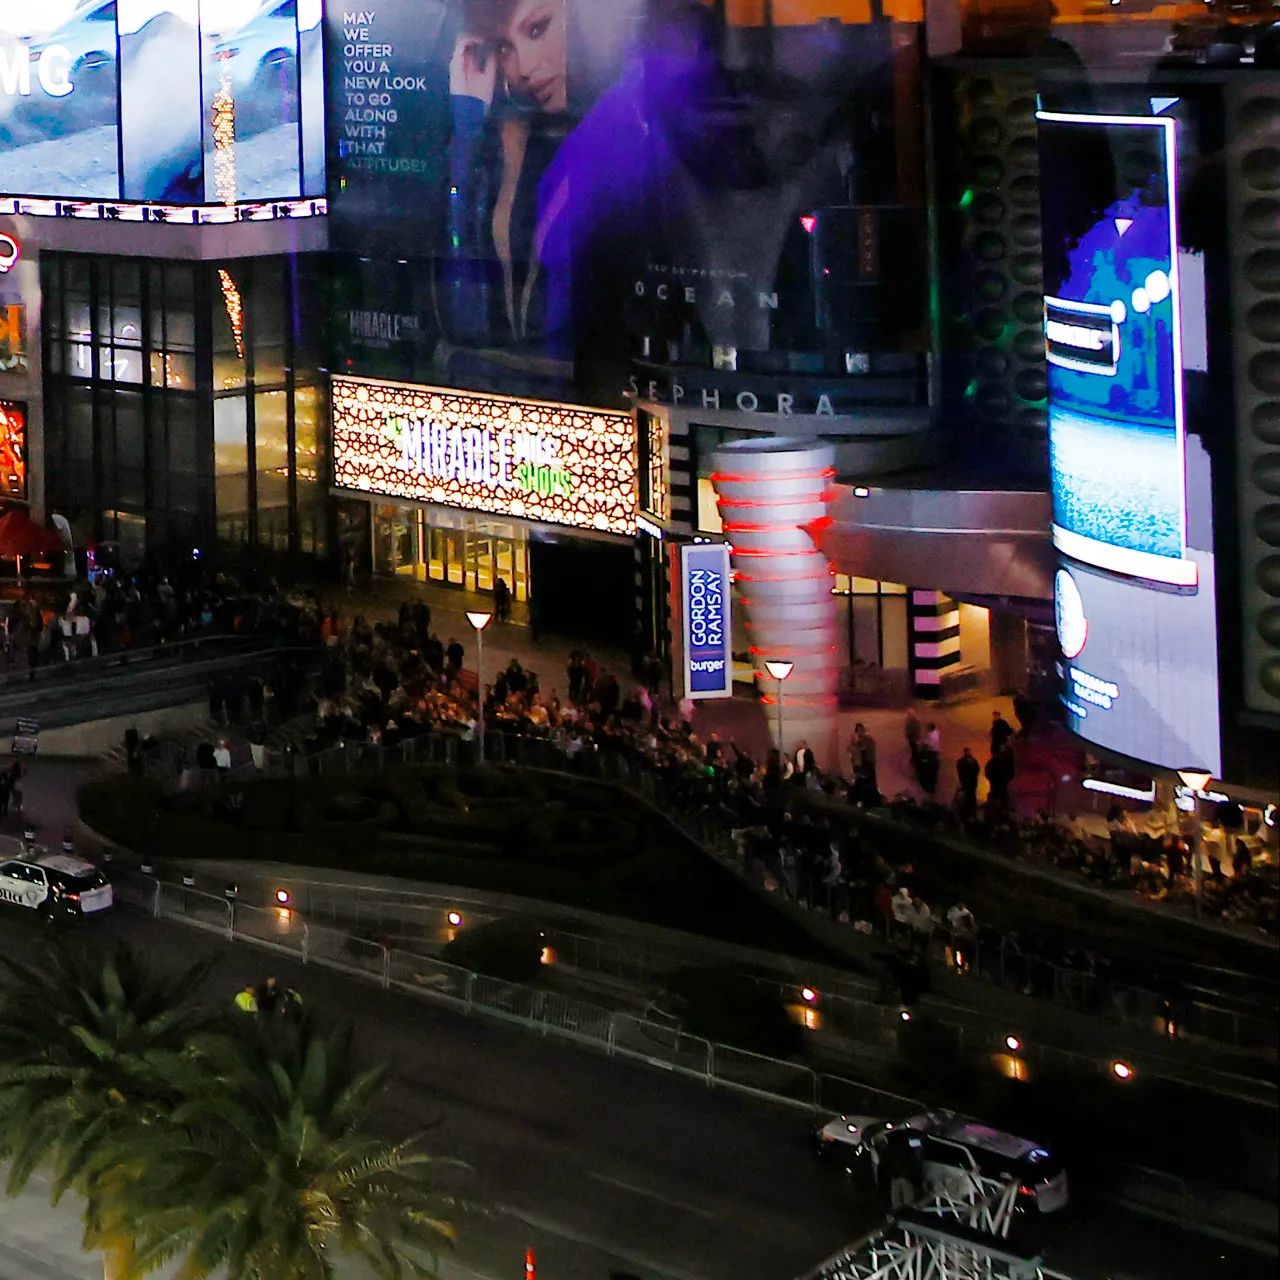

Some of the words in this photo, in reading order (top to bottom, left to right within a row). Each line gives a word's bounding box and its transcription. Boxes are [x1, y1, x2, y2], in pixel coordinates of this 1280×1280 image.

[343, 11, 375, 25] MAY
[344, 28, 369, 41] WE
[344, 44, 392, 57] OFFER
[344, 60, 376, 73] YOU
[379, 61, 390, 73] A
[345, 76, 380, 89] NEW
[385, 77, 426, 90] LOOK
[345, 93, 365, 106] TO
[368, 93, 390, 106] GO
[344, 109, 398, 122] ALONG
[345, 125, 385, 138] WITH
[346, 141, 385, 154] THAT
[628, 376, 835, 417] SEPHORA
[402, 419, 514, 488] MIRACLE
[518, 463, 572, 498] SHOPS
[690, 569, 707, 646] GORDON
[707, 570, 722, 645] RAMSAY
[690, 659, 724, 673] burger
